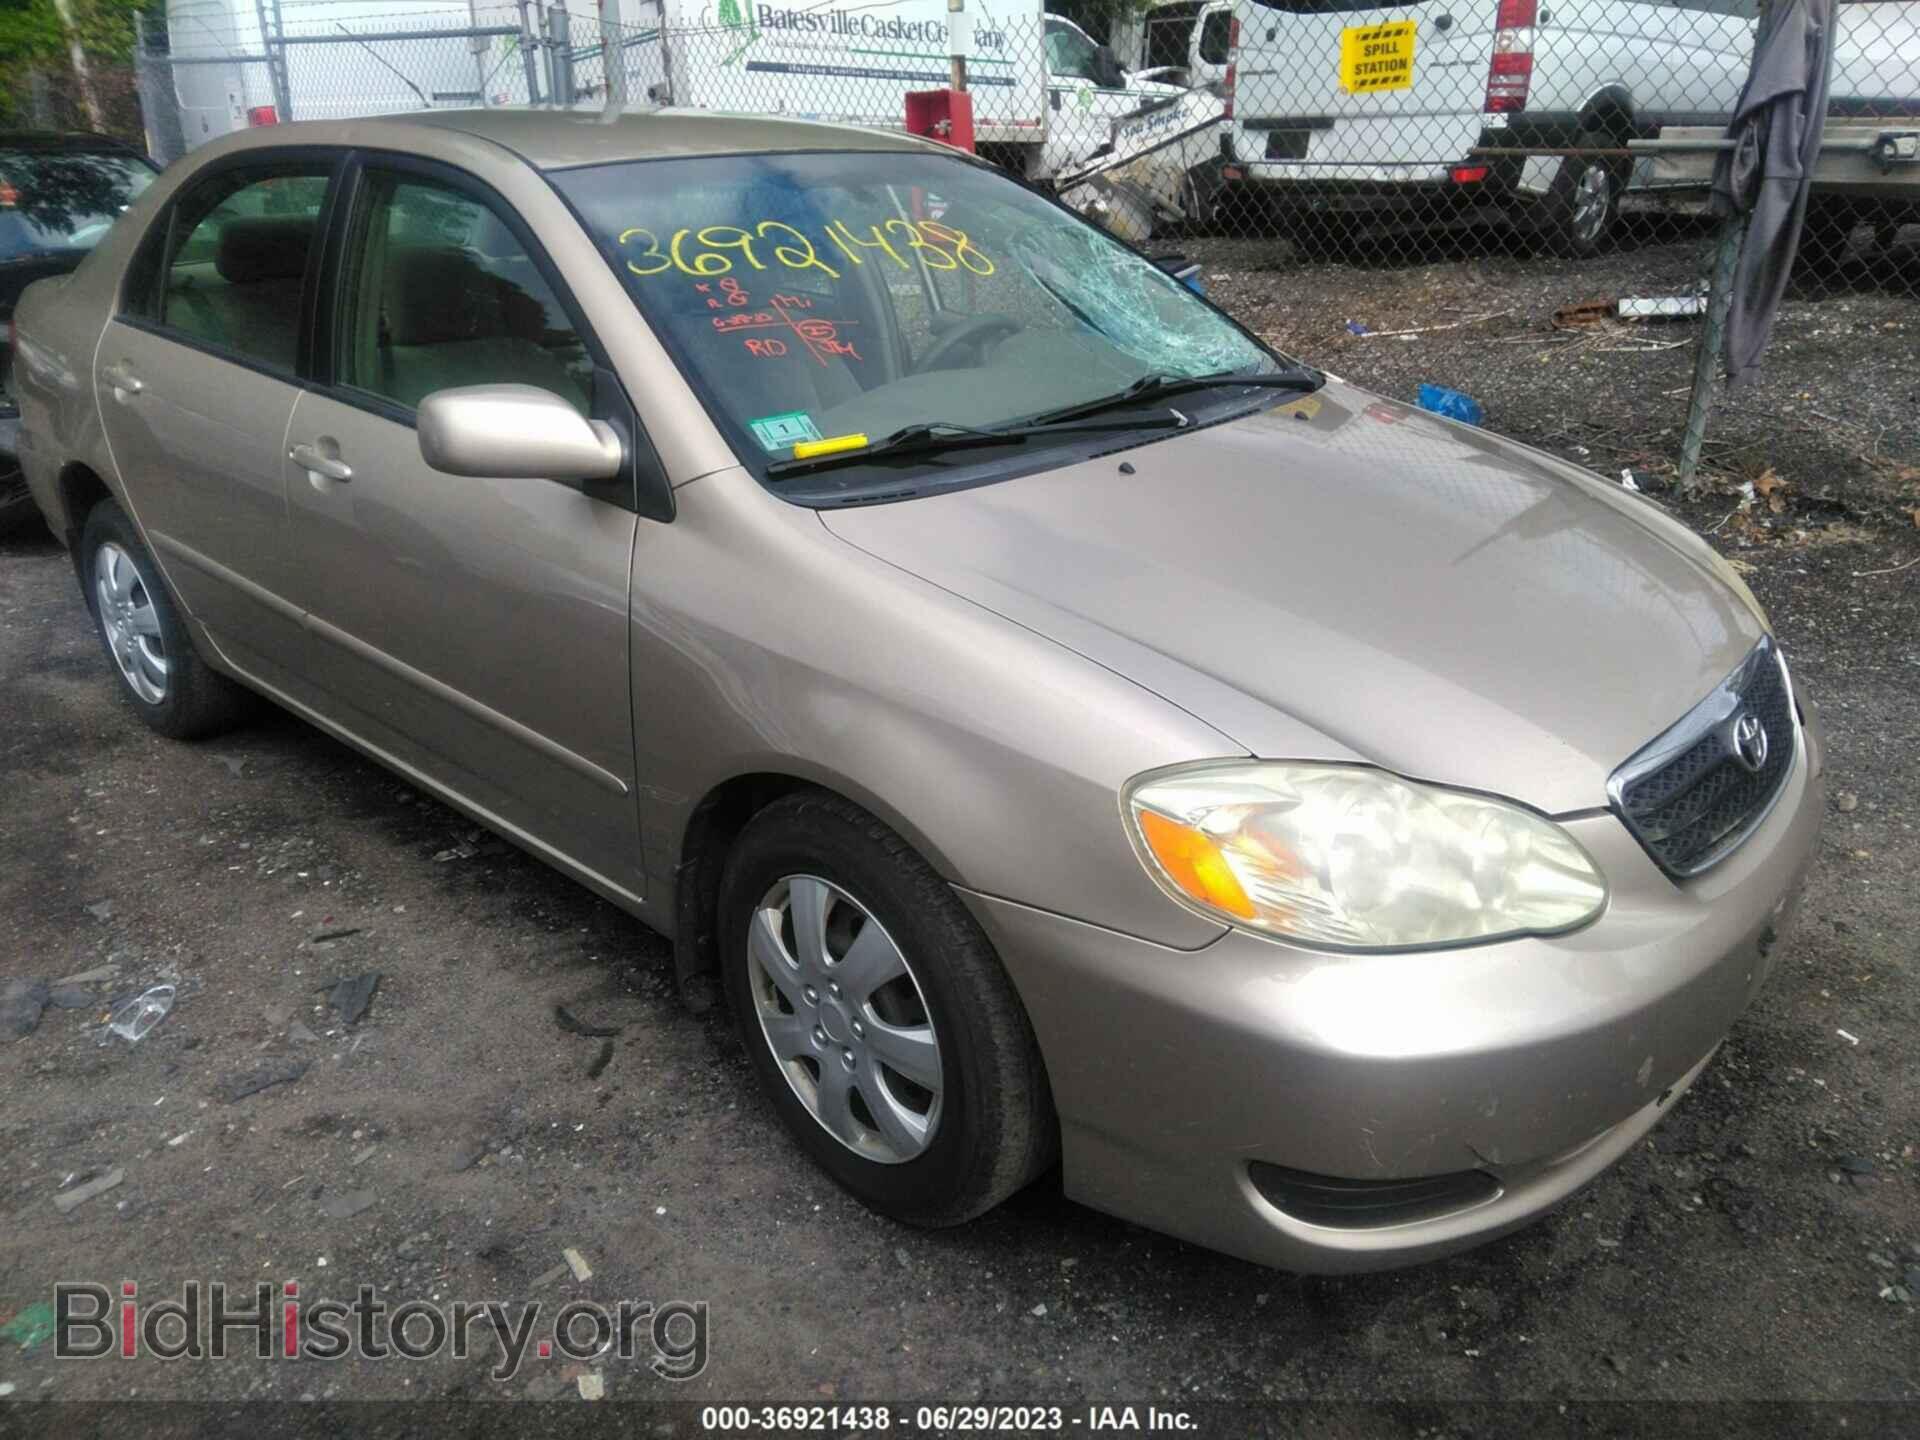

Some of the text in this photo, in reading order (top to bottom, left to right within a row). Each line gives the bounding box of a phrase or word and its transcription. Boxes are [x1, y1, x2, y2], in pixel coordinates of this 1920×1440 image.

[925, 20, 1007, 53] Coany
[1364, 42, 1399, 57] SPILL
[1355, 58, 1408, 75] STATION
[619, 220, 994, 278] 36921438
